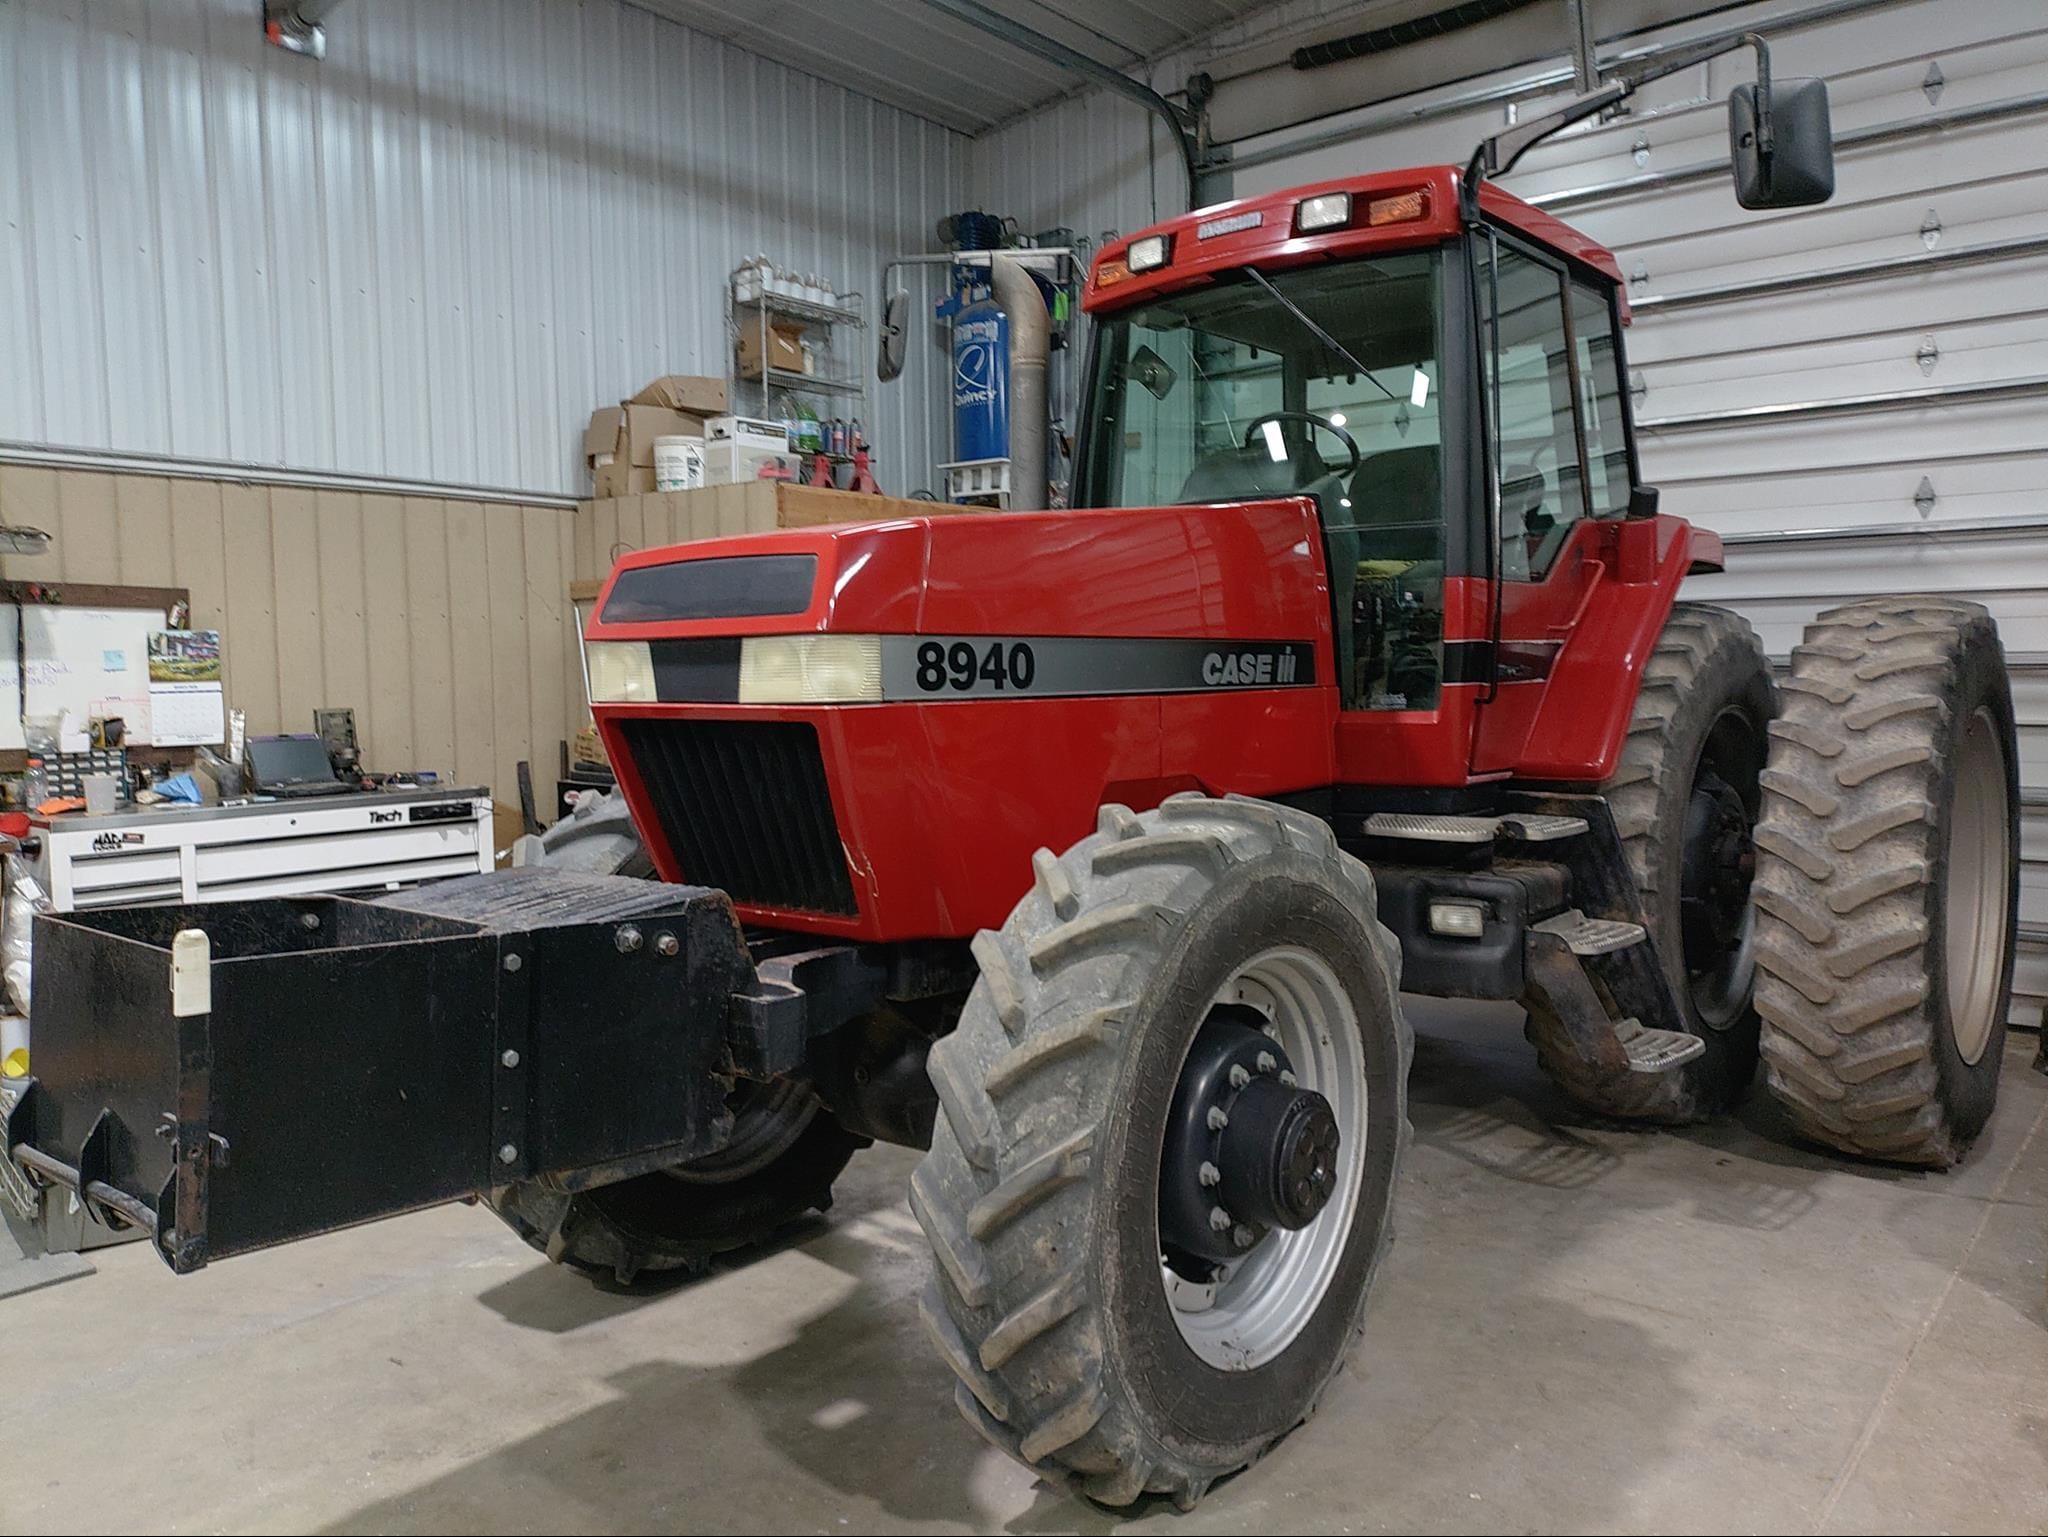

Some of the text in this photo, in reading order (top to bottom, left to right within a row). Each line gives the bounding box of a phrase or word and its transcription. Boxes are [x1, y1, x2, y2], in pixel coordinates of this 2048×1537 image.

[916, 641, 1035, 692] 8940
[1202, 652, 1273, 686] CASE
[369, 806, 402, 824] Tech
